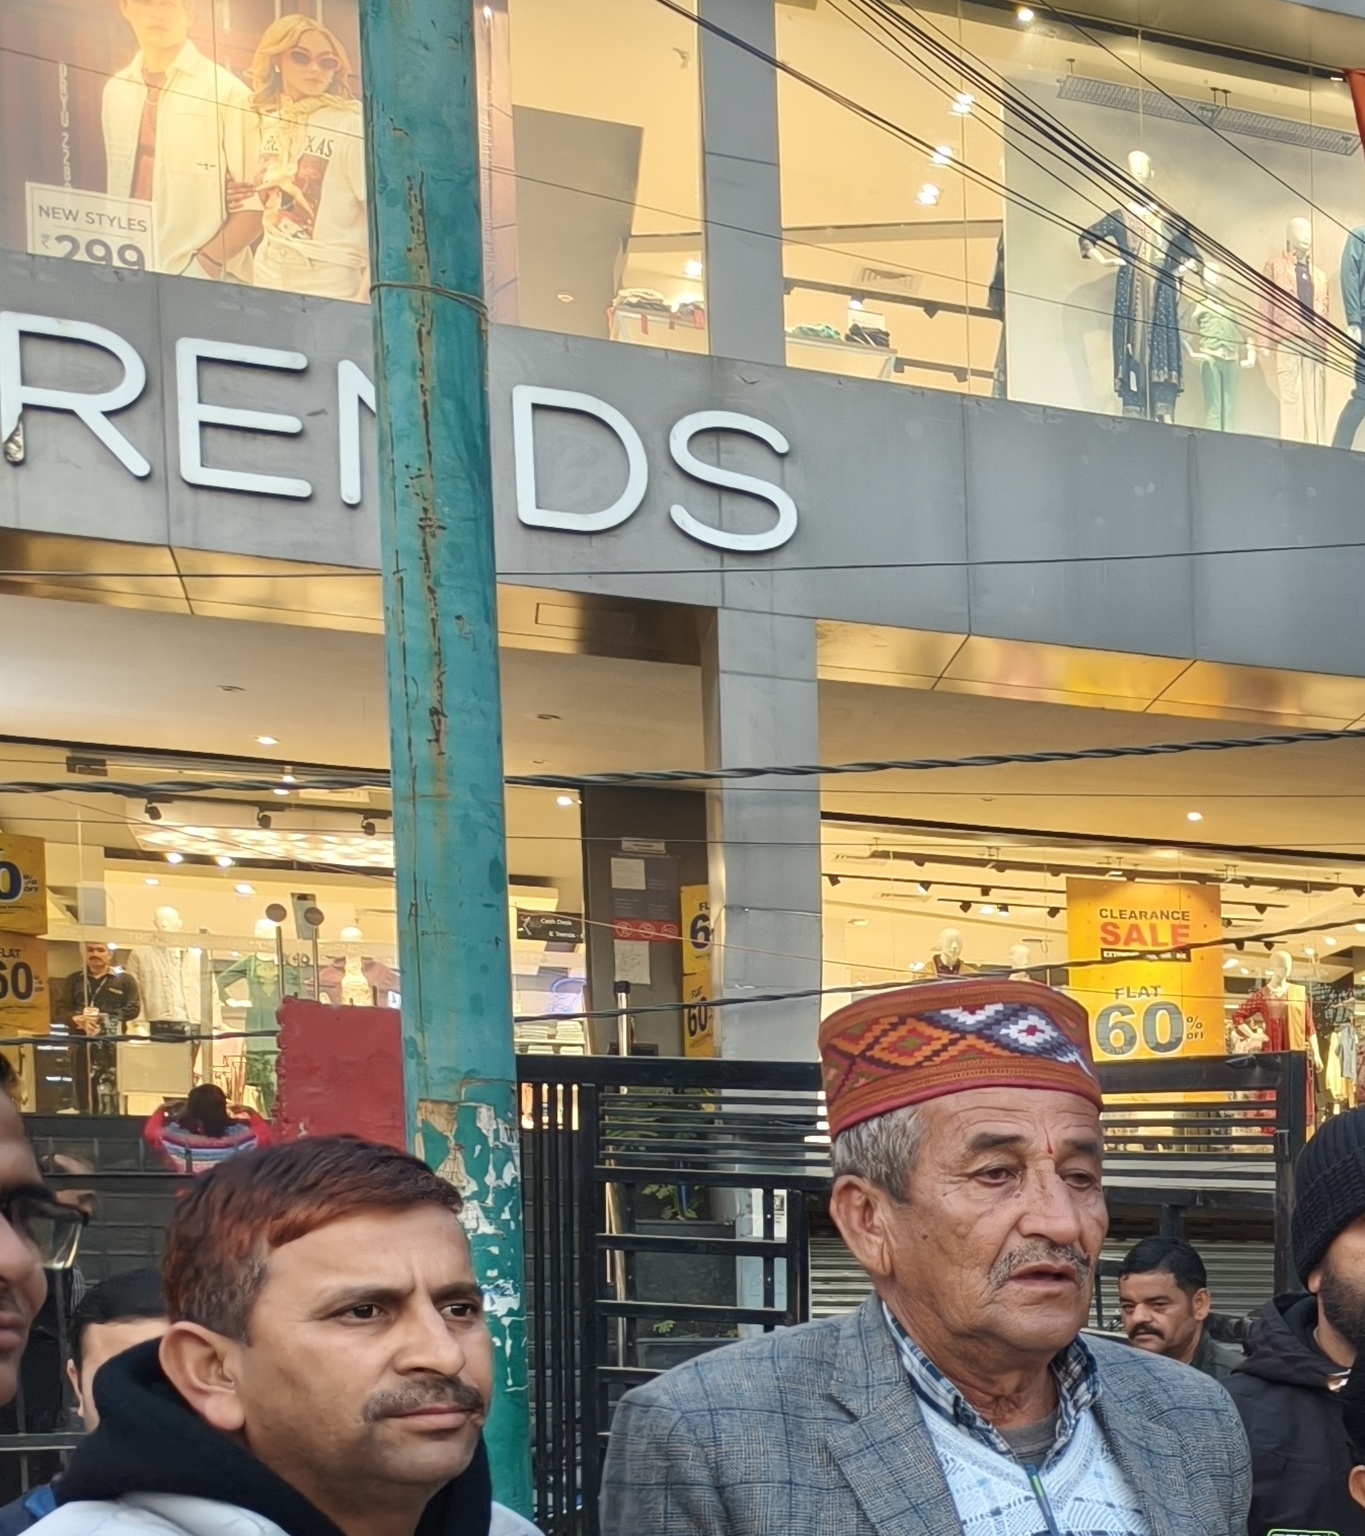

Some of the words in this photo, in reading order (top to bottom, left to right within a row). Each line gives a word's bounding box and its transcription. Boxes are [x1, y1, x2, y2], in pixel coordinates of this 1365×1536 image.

[38, 204, 79, 222] NEW
[85, 211, 147, 233] STYLES
[1099, 908, 1191, 922] CLEARANCE
[1100, 921, 1191, 948] SALE
[1114, 984, 1162, 1000] FLAT
[1095, 1001, 1184, 1055] 60
[1186, 1016, 1204, 1030] %
